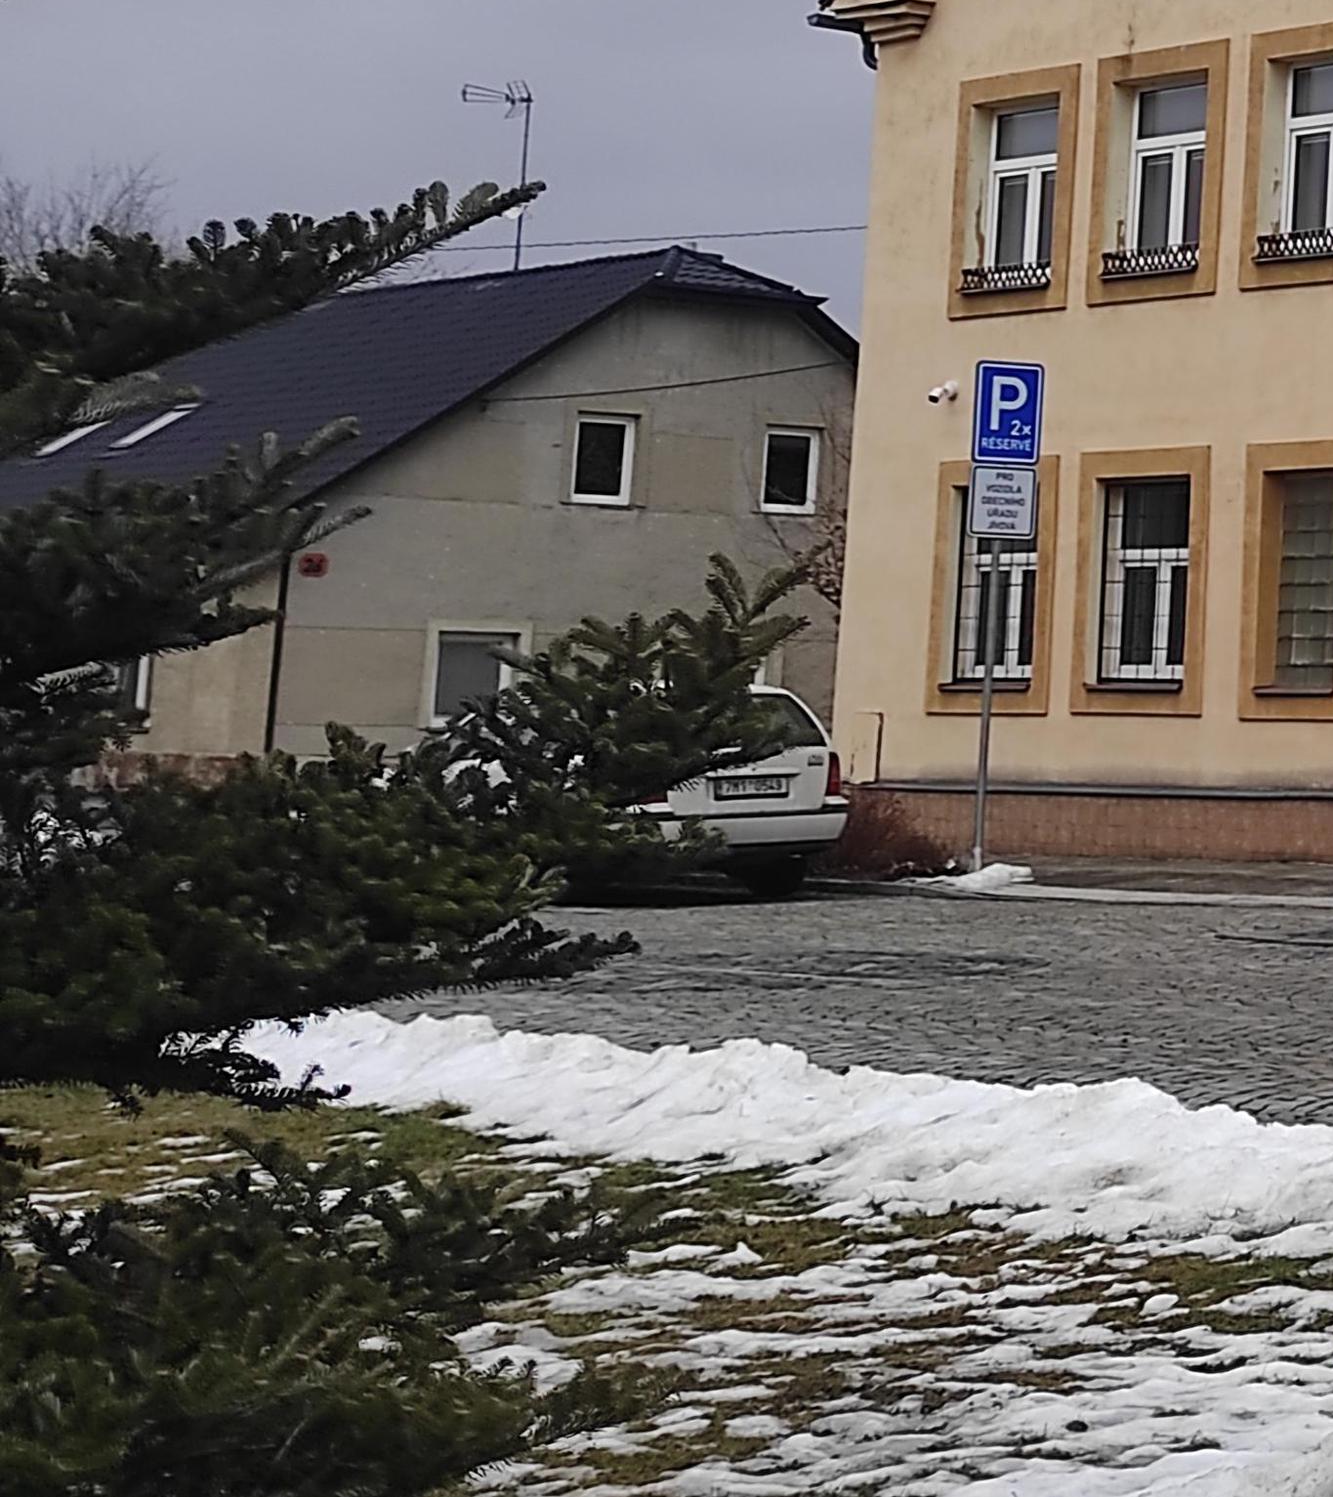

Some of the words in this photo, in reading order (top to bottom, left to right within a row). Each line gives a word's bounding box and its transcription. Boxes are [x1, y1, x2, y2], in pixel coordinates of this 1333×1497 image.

[990, 375, 1029, 431] P
[1010, 419, 1032, 436] 2x
[995, 472, 1015, 482] PRO
